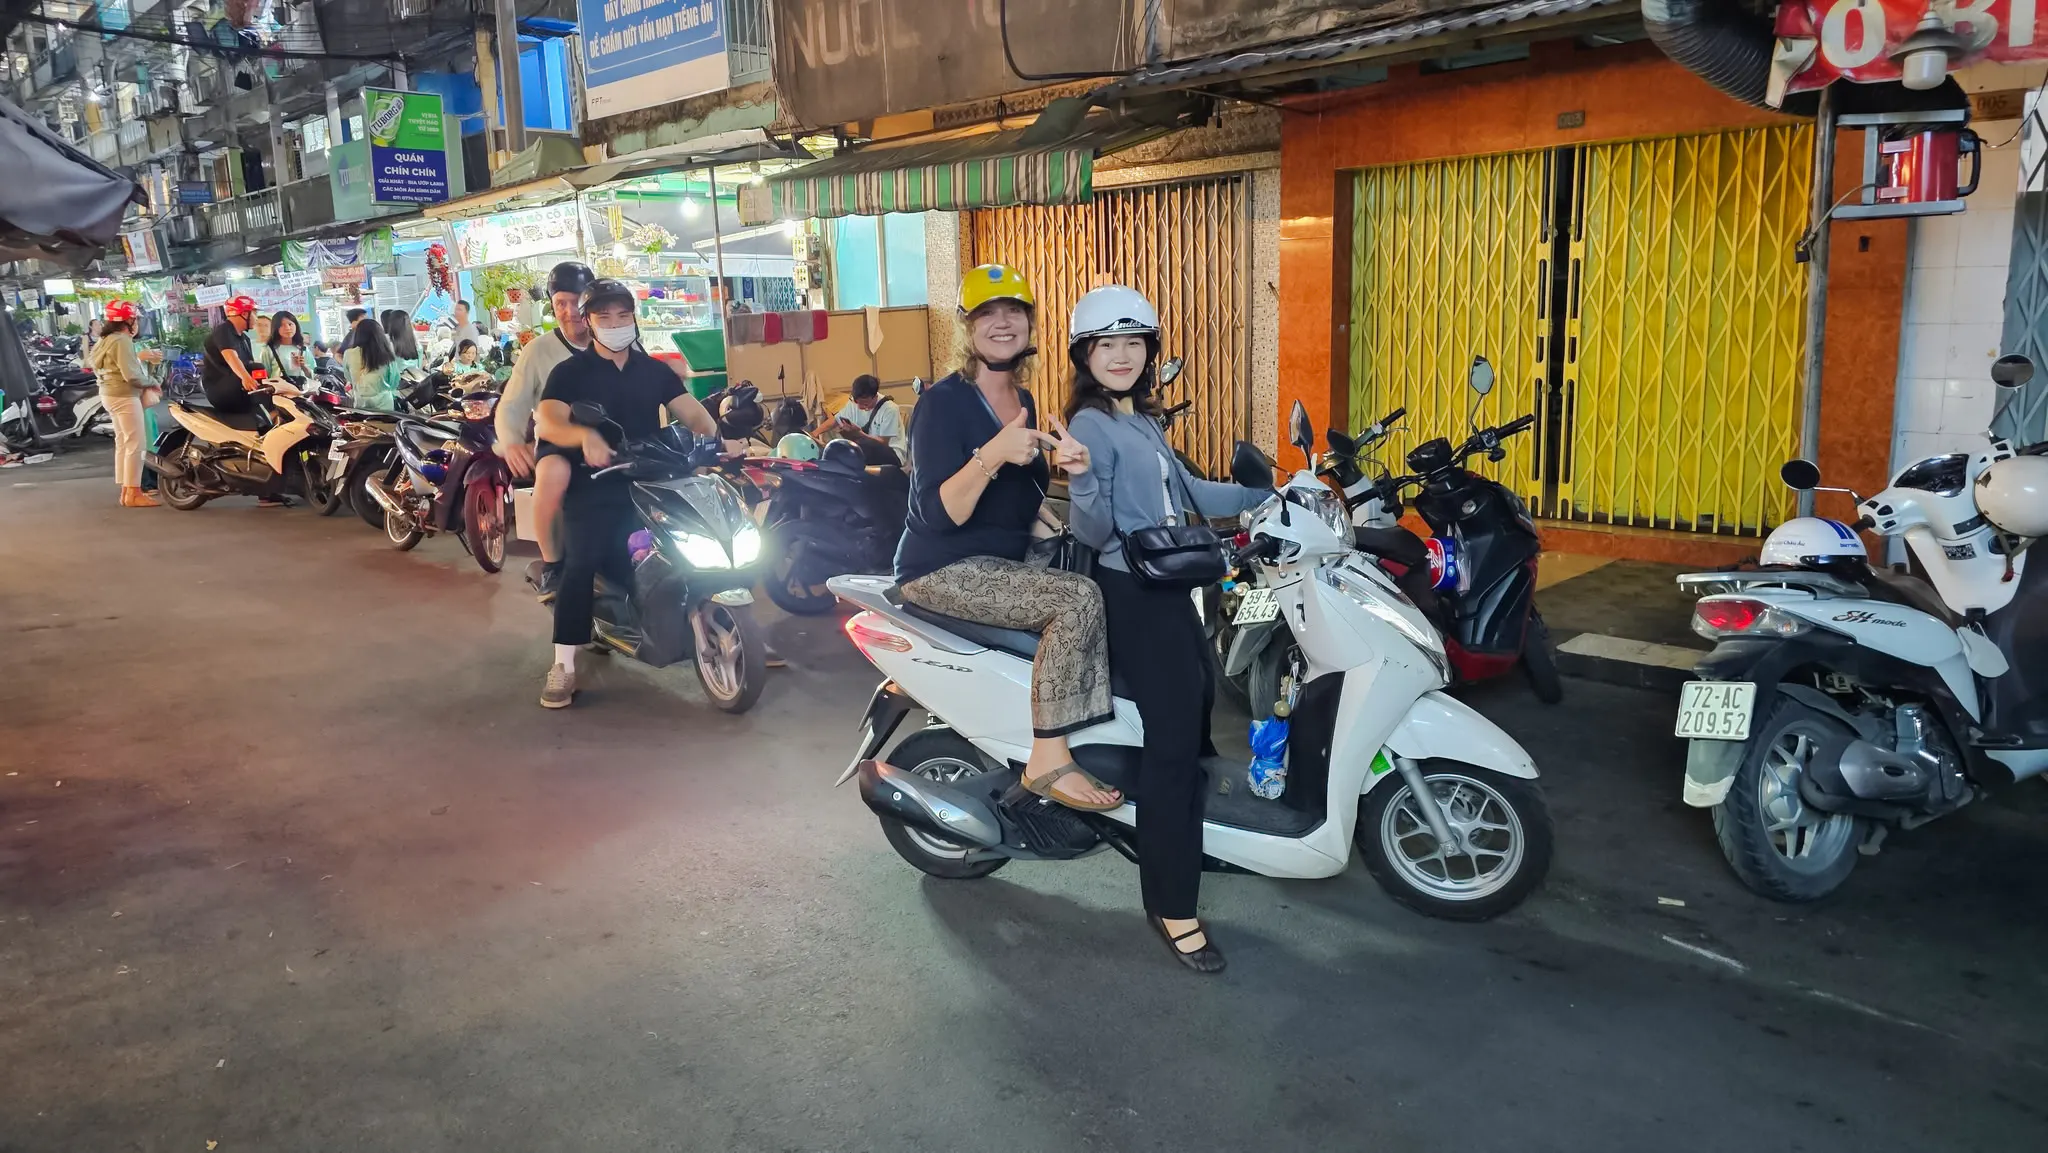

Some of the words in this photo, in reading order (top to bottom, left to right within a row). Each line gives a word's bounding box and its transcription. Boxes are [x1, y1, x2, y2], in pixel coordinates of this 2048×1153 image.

[674, 4, 699, 33] TIẾNG
[371, 103, 399, 132] TUBORG
[394, 153, 425, 163] QUÁN
[384, 166, 410, 176] CHÍN
[412, 167, 436, 177] CHÍN
[1237, 604, 1278, 621] 654.43
[1871, 617, 1907, 628] mode
[1692, 686, 1743, 709] 72-AC
[1681, 710, 1746, 736] 209.52
